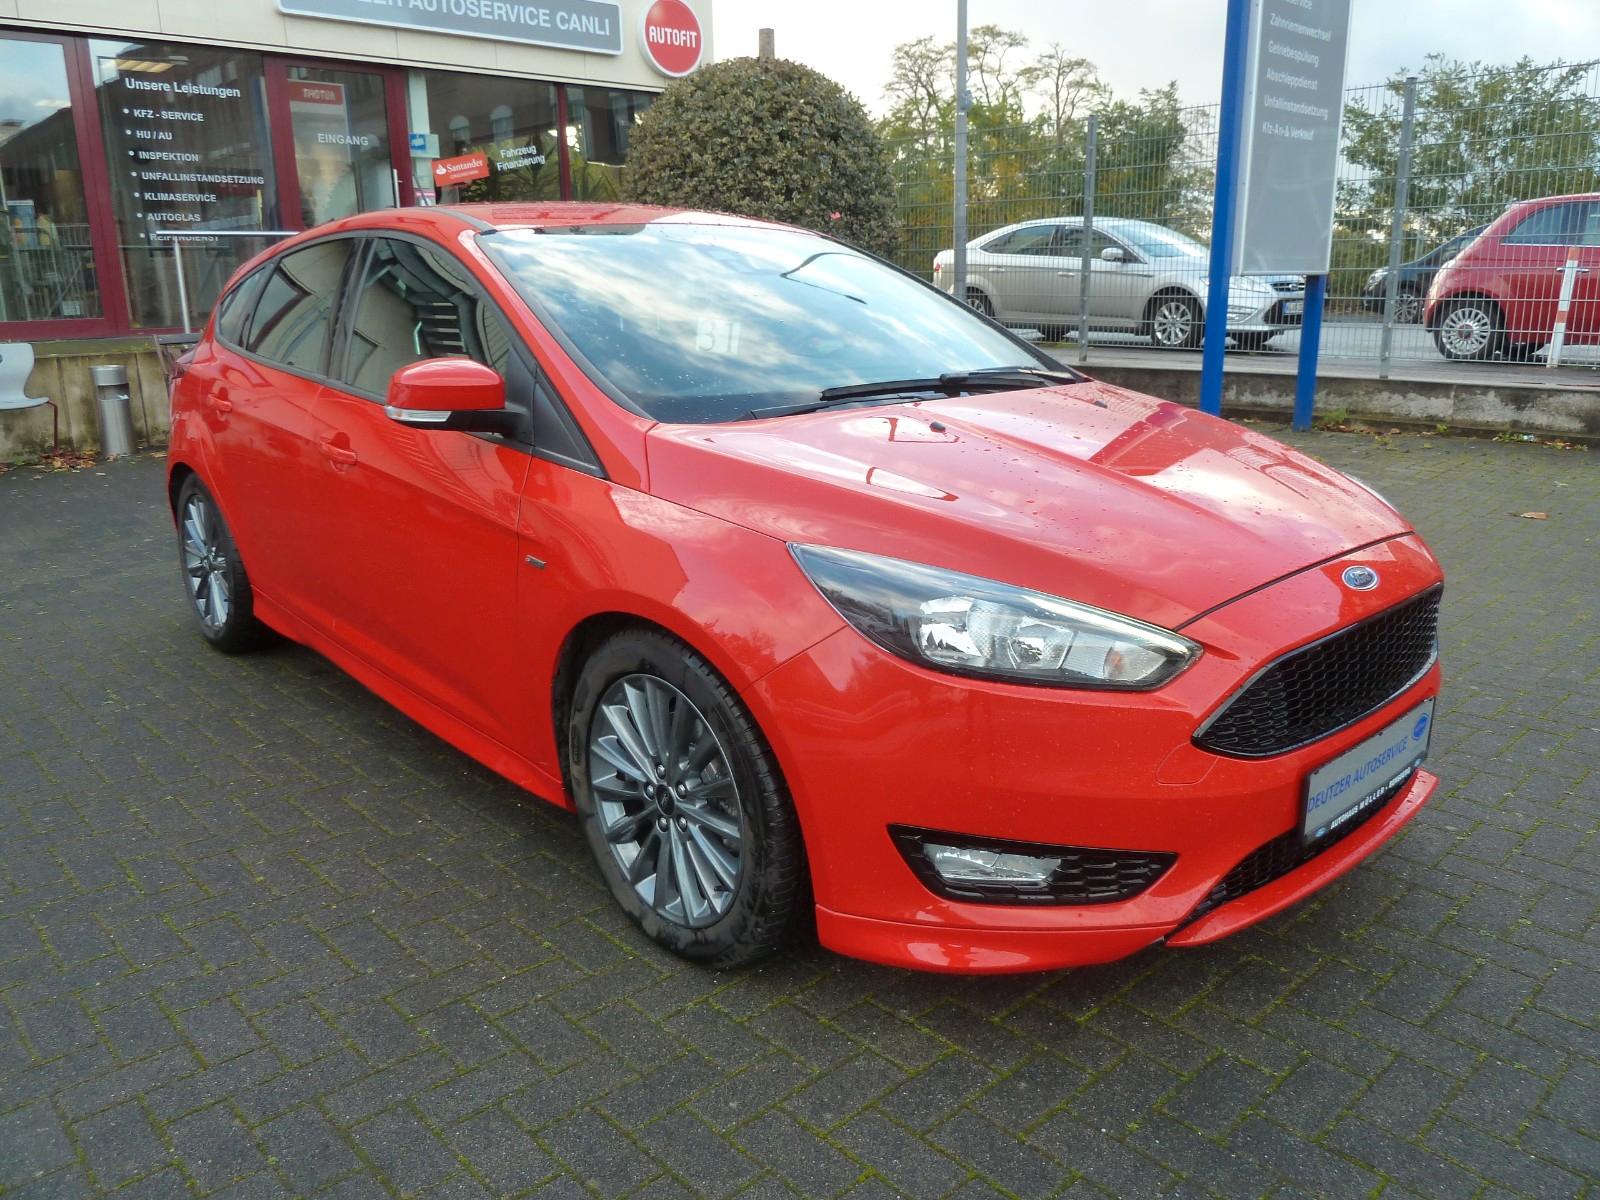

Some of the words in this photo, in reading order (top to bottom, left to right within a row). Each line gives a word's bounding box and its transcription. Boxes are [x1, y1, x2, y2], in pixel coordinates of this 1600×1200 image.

[555, 11, 610, 36] CANLI
[649, 25, 697, 48] AUTOFIT
[124, 77, 171, 92] Unsere
[173, 81, 241, 99] Leistungen
[133, 108, 154, 119] KFZ
[161, 110, 204, 122] SERVICE
[317, 133, 369, 146] EINGANG
[139, 150, 200, 162] INSPEKTION
[500, 145, 537, 159] Fahrzeug
[447, 158, 483, 173] Santander
[496, 154, 545, 172] Finanzierung
[142, 172, 265, 185] UNFALLINSTANDSETZUNG
[144, 192, 217, 203] KLIMASERVICE
[146, 212, 200, 222] AUTOGLAS
[1307, 773, 1353, 813] DEUTZER
[1353, 736, 1408, 784] AUTOSERVICE
